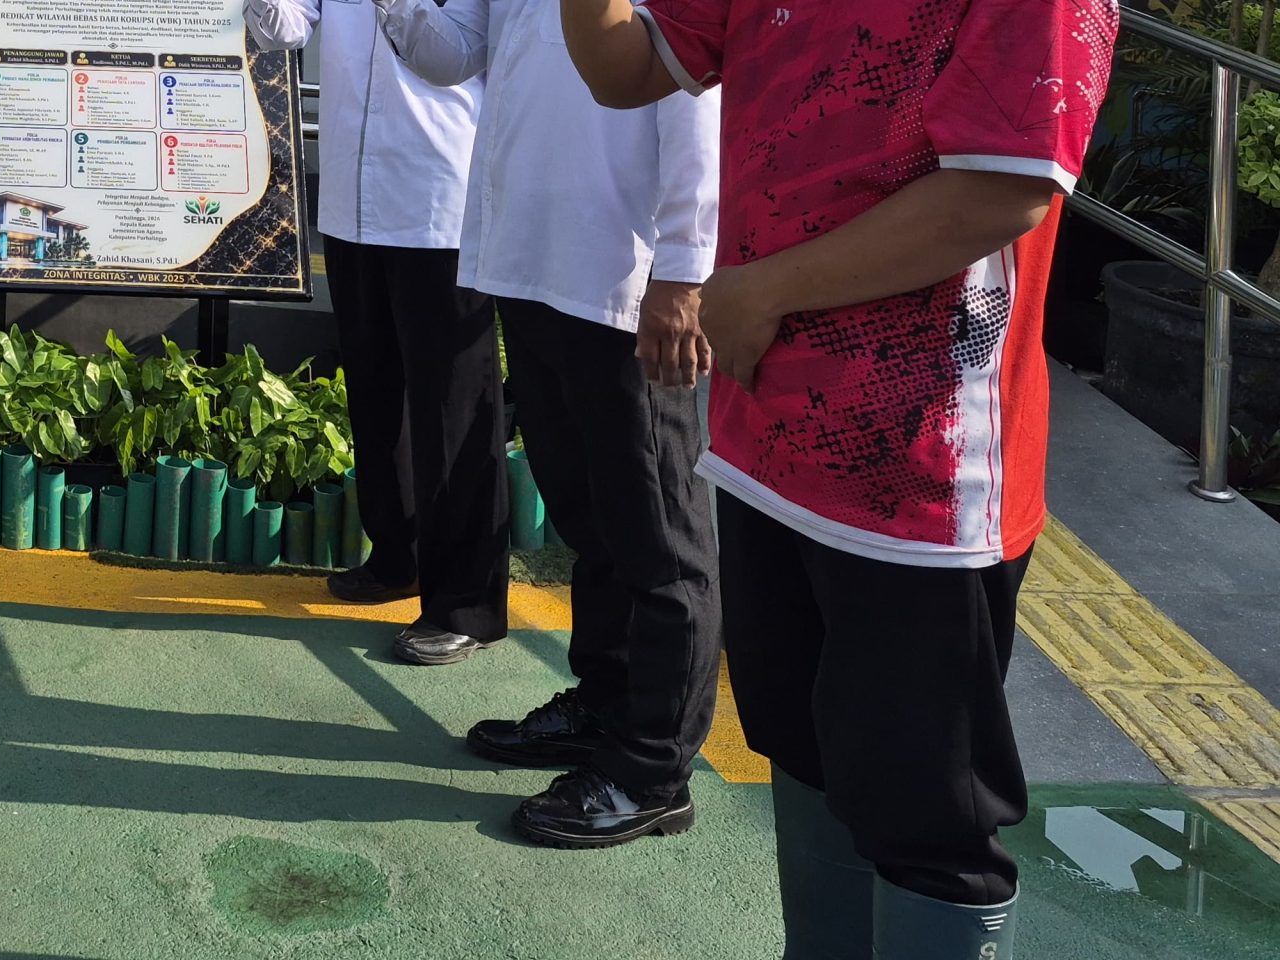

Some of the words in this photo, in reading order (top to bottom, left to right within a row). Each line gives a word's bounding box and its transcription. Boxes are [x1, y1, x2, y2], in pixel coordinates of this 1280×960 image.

[36, 13, 72, 21] WILAYAH
[73, 14, 98, 22] BEBAS
[120, 16, 154, 24] KORUPSI
[156, 17, 182, 26] (WBK)
[211, 18, 232, 26] 2025
[3, 50, 44, 58] PENANGGUNG
[80, 75, 85, 83] 2
[167, 78, 174, 86] 3
[79, 135, 85, 143] 5
[167, 137, 175, 146] 6
[183, 215, 223, 224] SEHATI
[96, 254, 119, 263] Zahid
[121, 255, 155, 264] Khasani,
[43, 269, 70, 278] ZONA
[72, 270, 126, 280] INTEGRITAS
[137, 272, 160, 281] WBK
[162, 273, 185, 283] 2025
